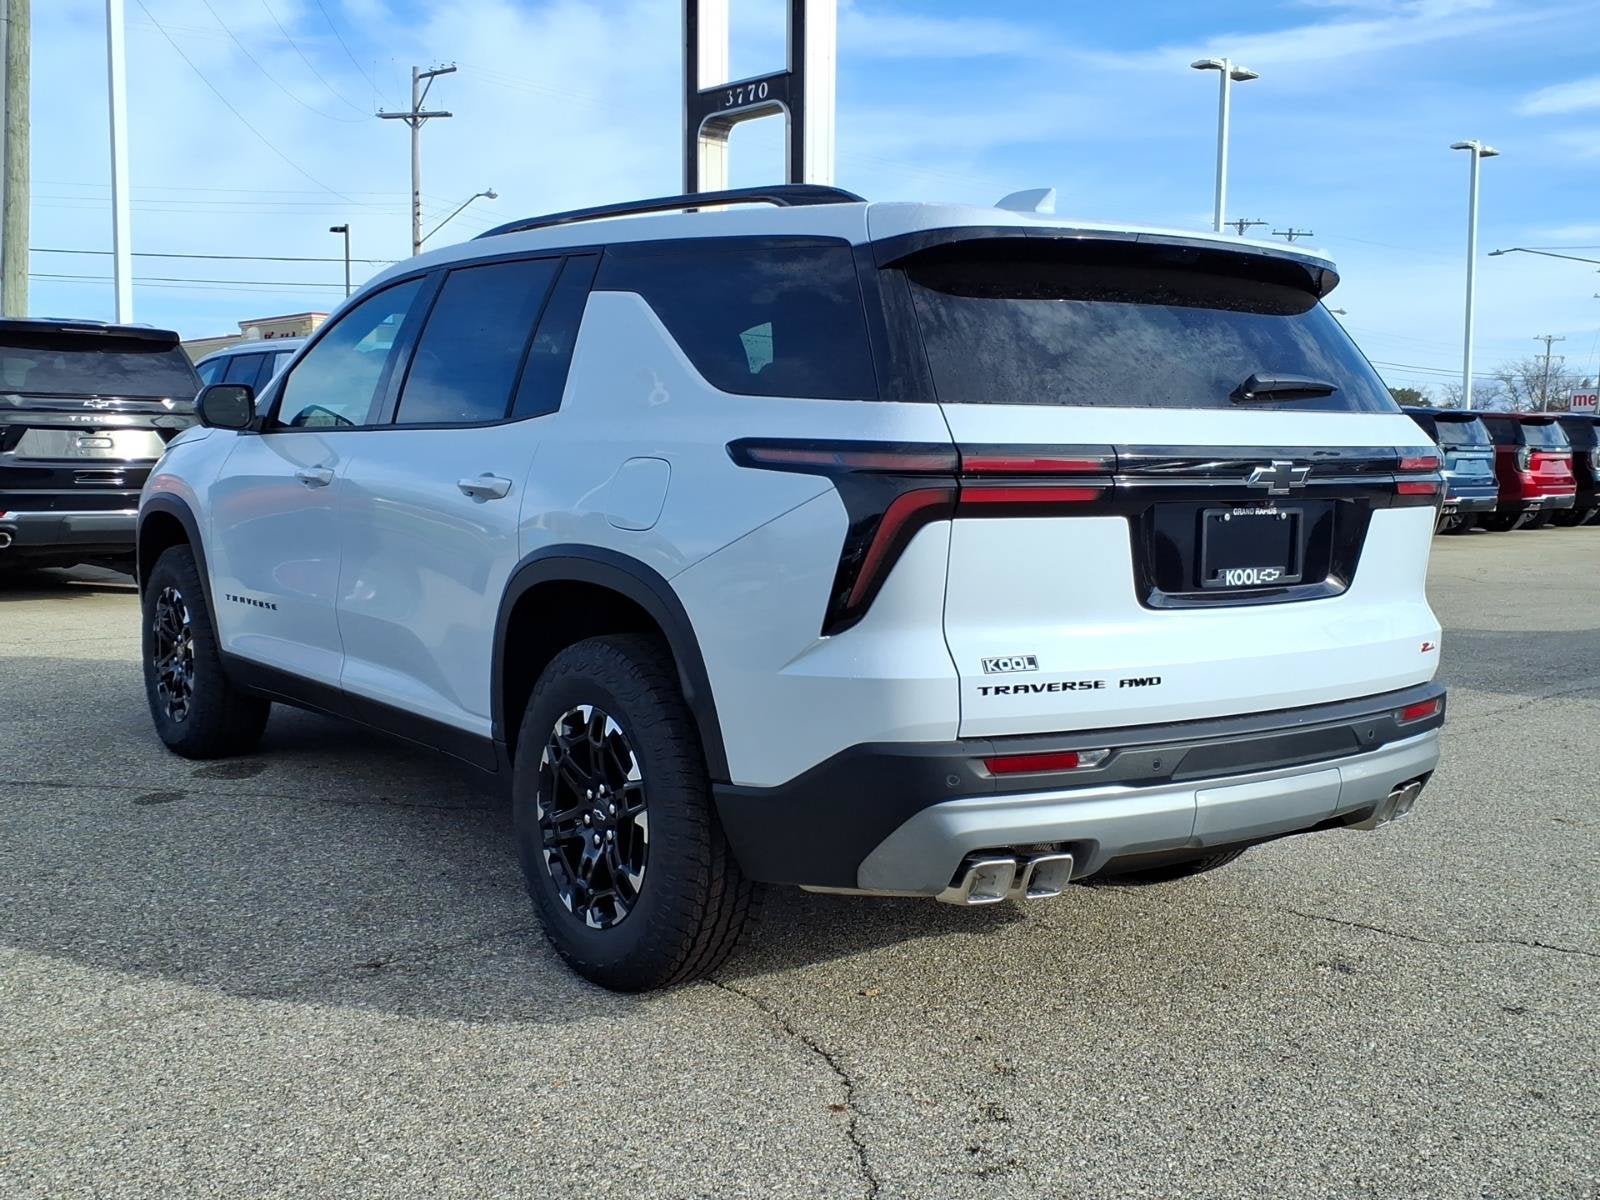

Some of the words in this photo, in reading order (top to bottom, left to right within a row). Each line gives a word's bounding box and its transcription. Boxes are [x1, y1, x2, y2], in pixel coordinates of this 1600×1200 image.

[725, 82, 768, 106] 3770
[1232, 507, 1254, 516] GRAND
[1225, 568, 1261, 586] KOOL
[224, 593, 278, 611] TRAVERSE
[982, 655, 1038, 674] KOOL
[977, 680, 1106, 696] TRAVERSE
[1118, 676, 1162, 689] AWD
